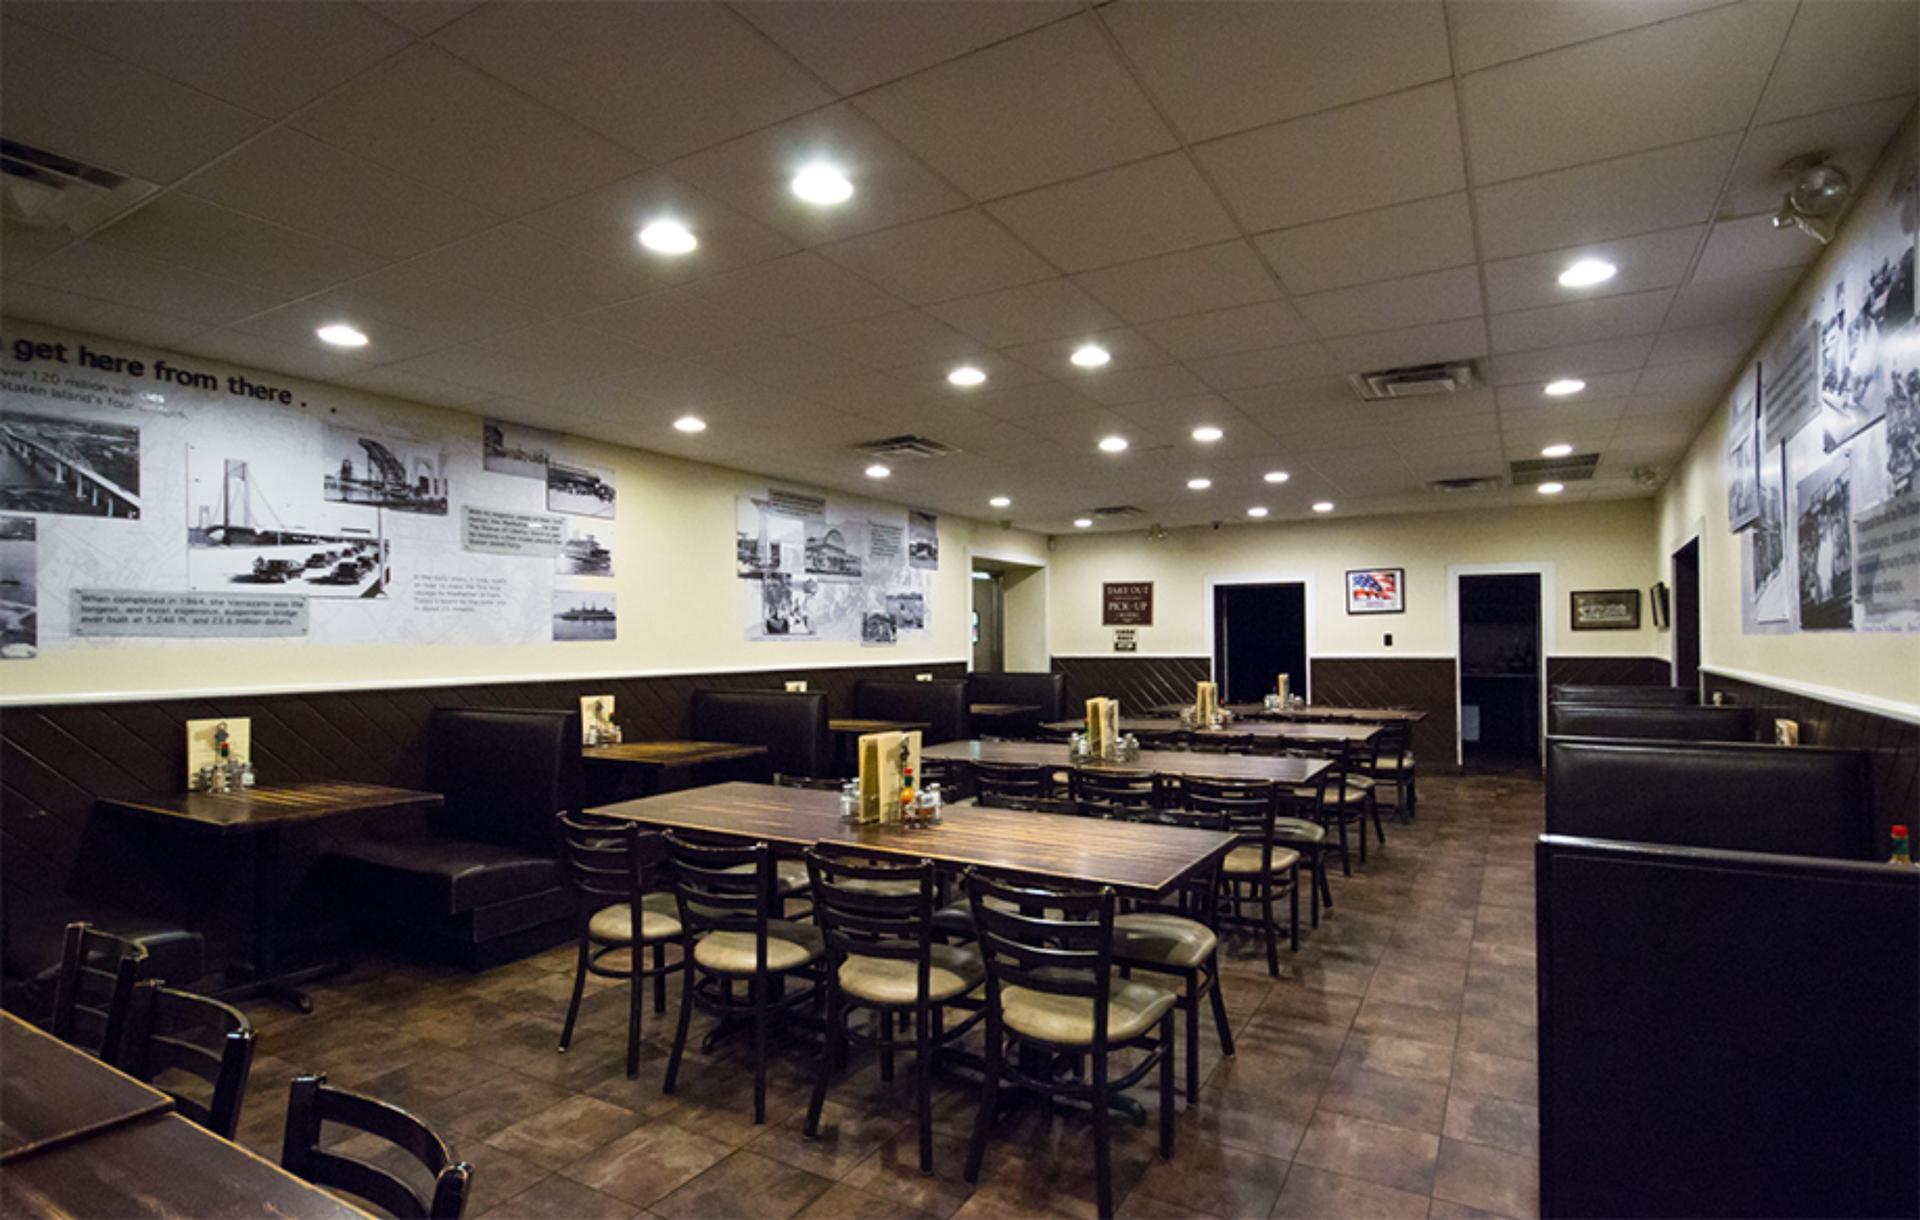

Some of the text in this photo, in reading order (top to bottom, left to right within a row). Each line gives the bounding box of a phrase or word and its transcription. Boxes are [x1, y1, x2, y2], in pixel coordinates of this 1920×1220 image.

[13, 338, 69, 364] get
[79, 345, 144, 377] here
[153, 360, 217, 390] from
[227, 376, 292, 405] there
[32, 370, 60, 385] 120
[64, 377, 109, 391] million
